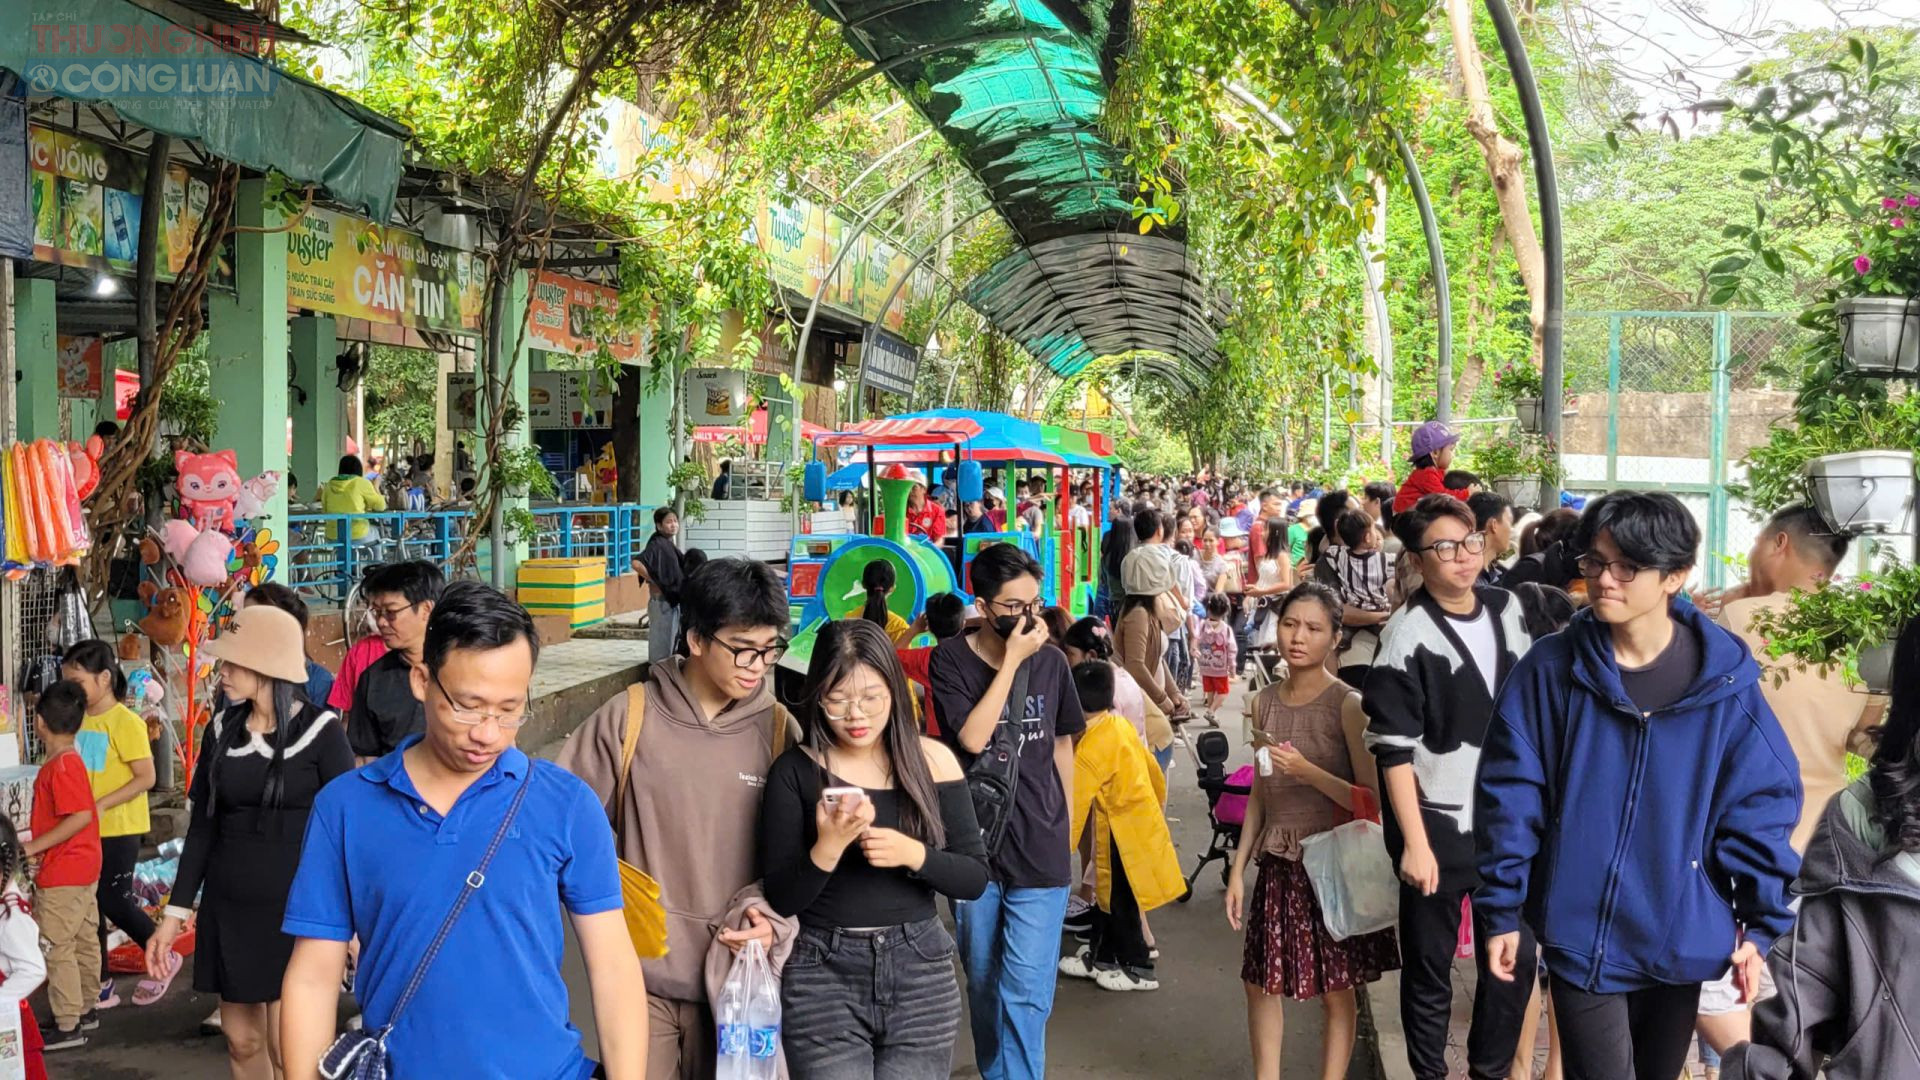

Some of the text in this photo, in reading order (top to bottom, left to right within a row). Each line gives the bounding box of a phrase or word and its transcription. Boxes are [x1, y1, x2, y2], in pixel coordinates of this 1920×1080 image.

[55, 143, 109, 181] UỐNG
[769, 206, 805, 253] Twister
[353, 258, 405, 313] CĂN
[411, 278, 445, 320] TIN
